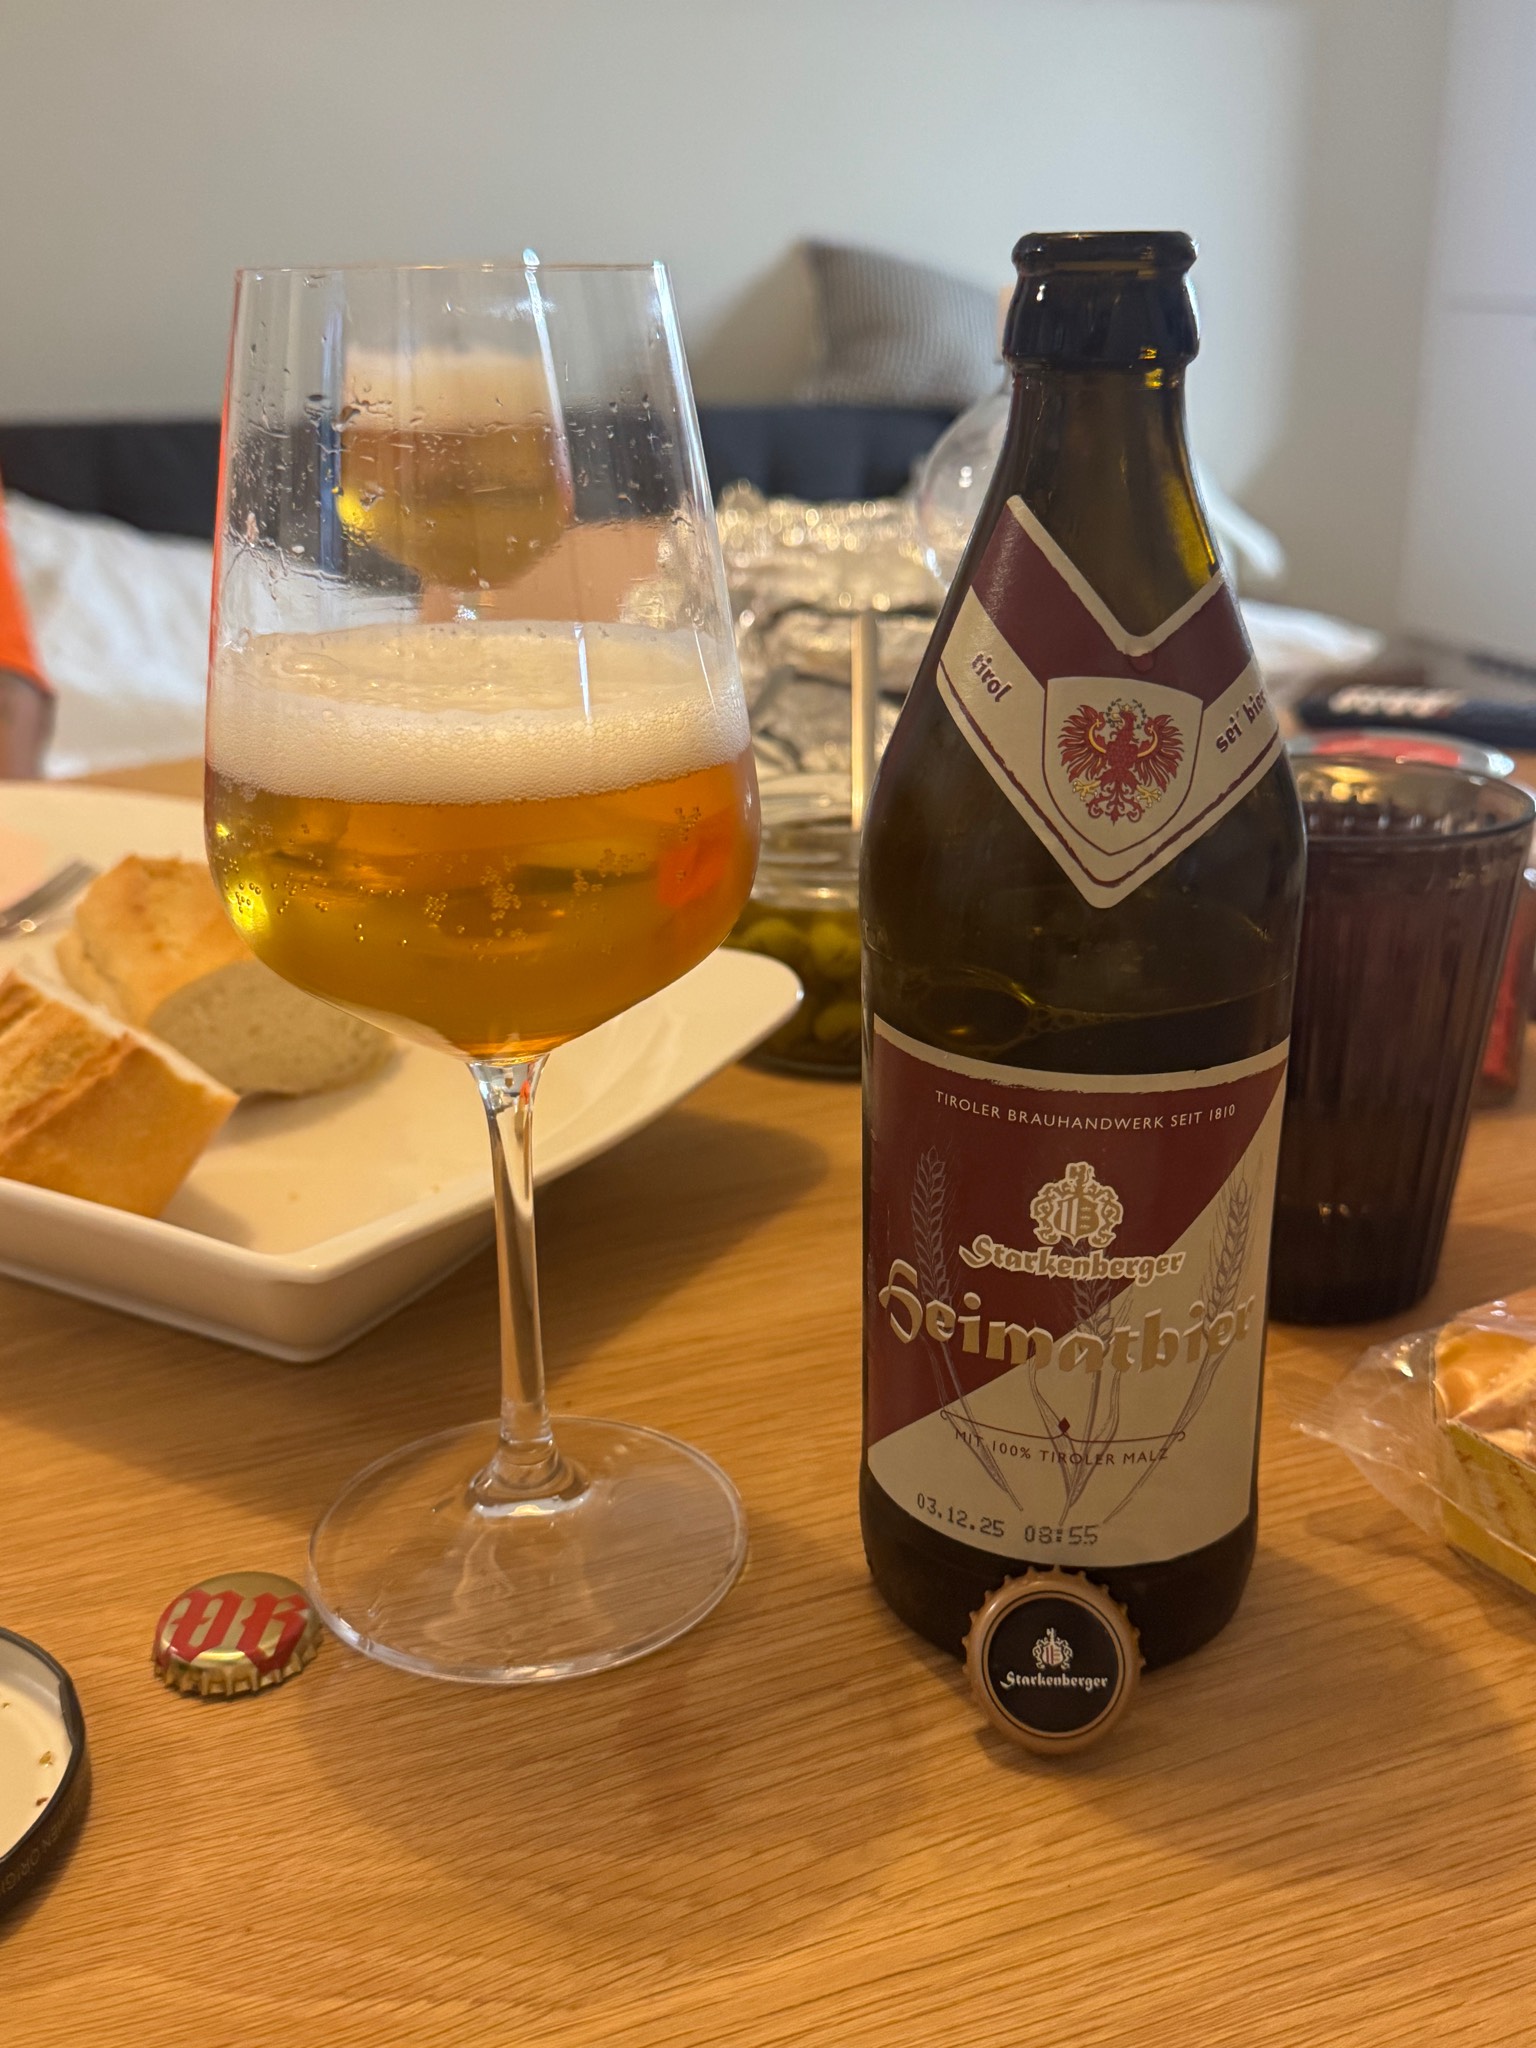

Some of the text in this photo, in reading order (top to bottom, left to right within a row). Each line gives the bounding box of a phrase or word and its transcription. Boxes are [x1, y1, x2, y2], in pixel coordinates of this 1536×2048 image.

[970, 652, 1012, 703] tirol
[935, 1089, 1236, 1131] TIROLER BRAUHANDWERK SEIT 1810
[958, 1233, 1187, 1288] Starkenberger
[878, 1259, 1255, 1374] Heimatbier
[954, 1430, 1169, 1466] MIT 100% TIROLER MALZ
[916, 1492, 1100, 1546] 03.12.25 08:55
[999, 1669, 1109, 1693] Starkenberger
